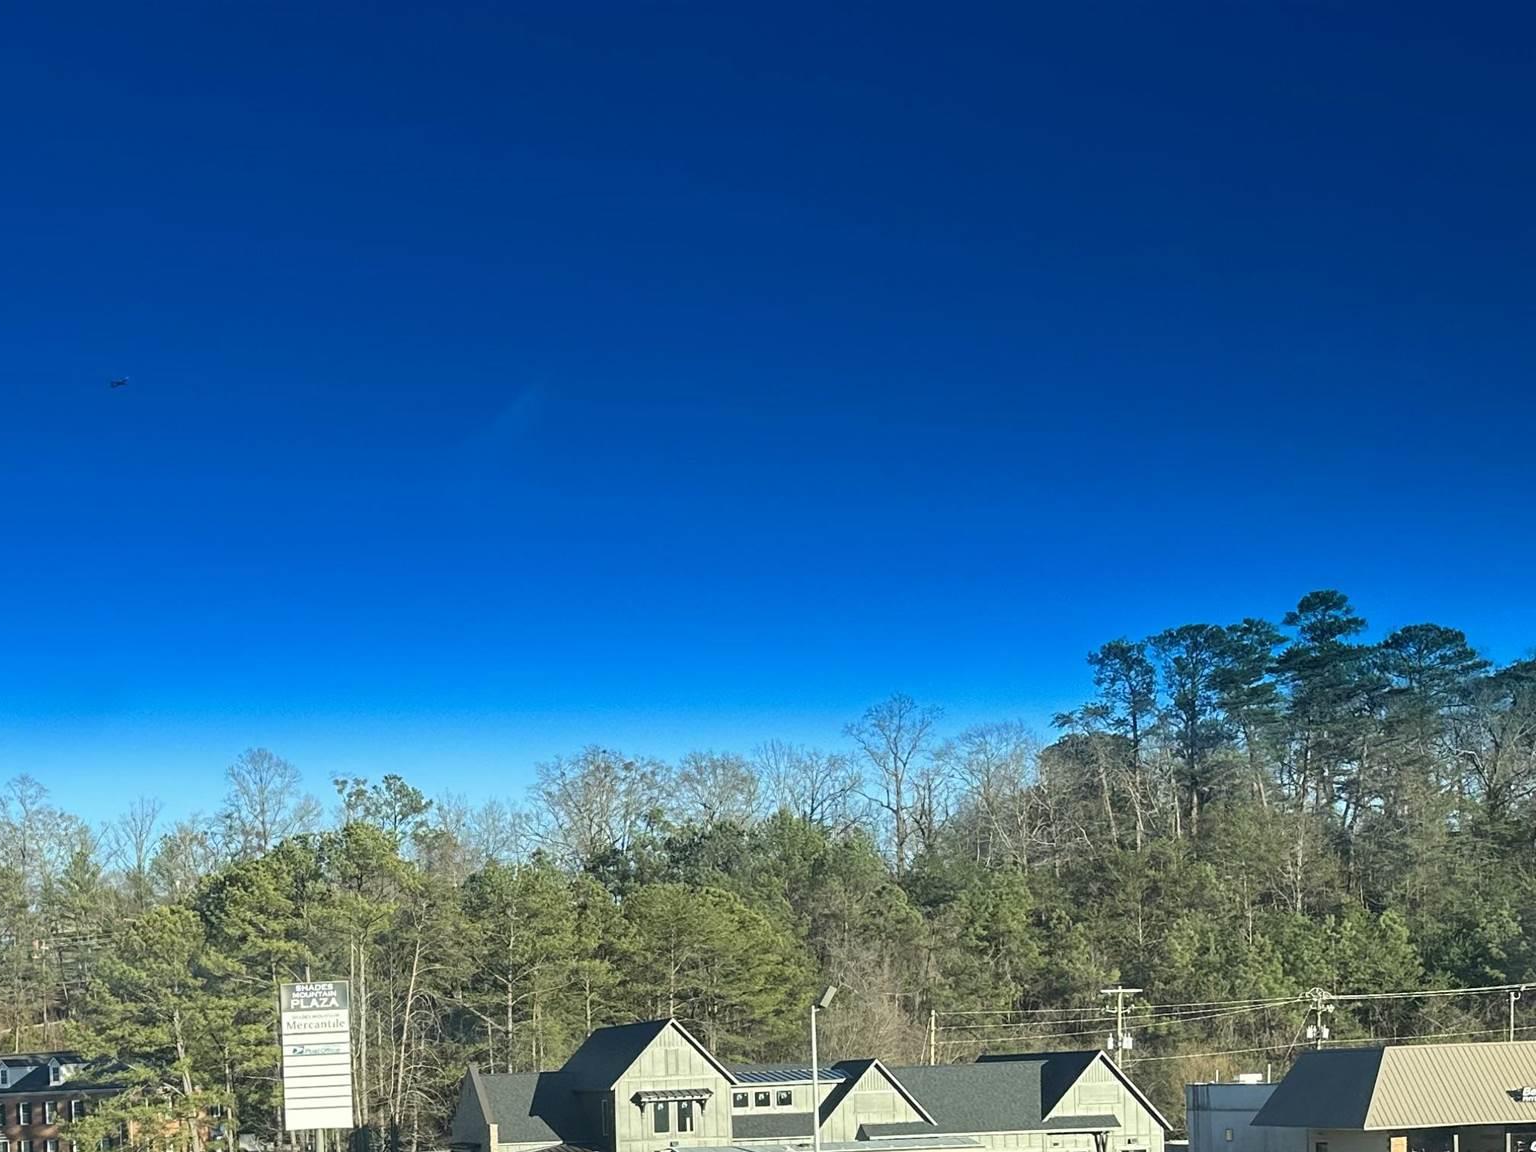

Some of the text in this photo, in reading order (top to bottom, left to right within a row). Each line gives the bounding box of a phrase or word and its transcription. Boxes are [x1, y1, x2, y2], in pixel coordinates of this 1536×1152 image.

[295, 984, 333, 992] SHADES
[292, 990, 337, 999] MOUNTAIN
[290, 997, 339, 1009] PLAZA
[286, 1018, 345, 1030] Mercantile
